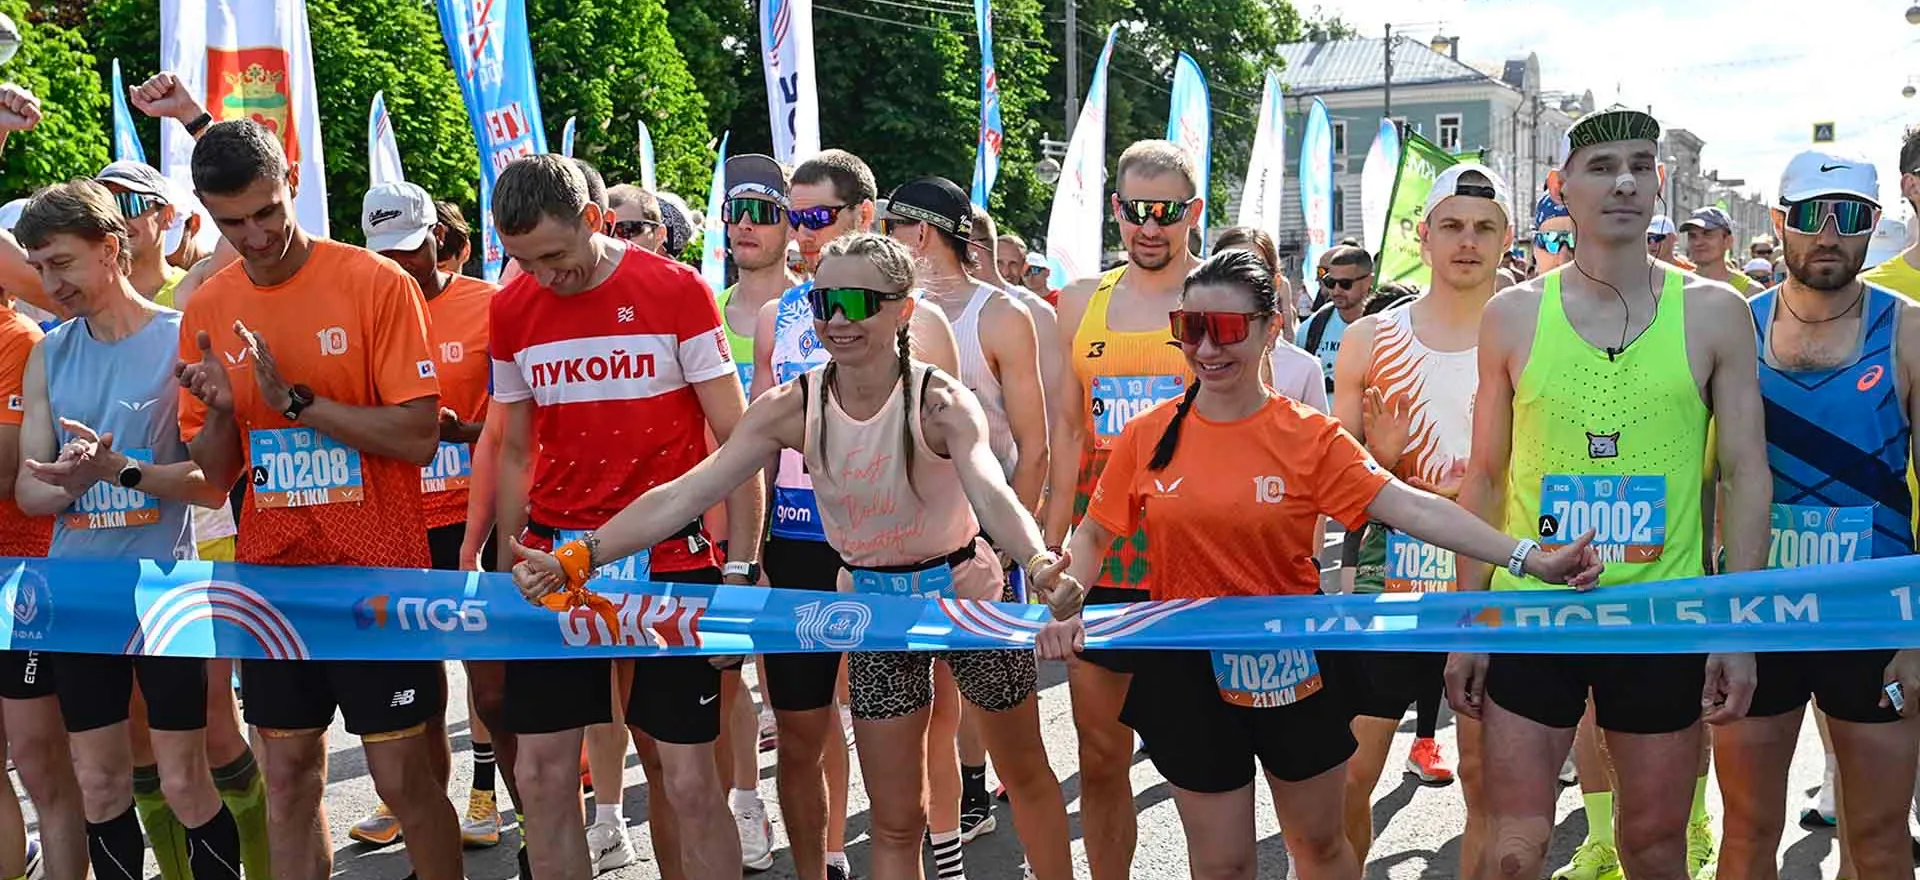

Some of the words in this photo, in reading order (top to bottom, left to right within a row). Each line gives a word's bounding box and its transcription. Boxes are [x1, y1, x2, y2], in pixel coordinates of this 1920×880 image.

[316, 327, 348, 356] 10
[439, 341, 464, 363] 10
[531, 349, 656, 389] ЛУКОЙЛ
[261, 447, 349, 490] 70208
[1253, 475, 1286, 503] 10
[777, 505, 811, 524] grom
[1552, 500, 1652, 542] 70002
[1394, 543, 1456, 579] 7029
[1768, 528, 1858, 569] 70007
[397, 596, 489, 632] ПСБ
[558, 593, 709, 648] СТАРТ
[1676, 600, 1707, 624] 5
[1889, 586, 1920, 621] 1
[794, 600, 872, 650] 10
[1223, 649, 1311, 690] 70229
